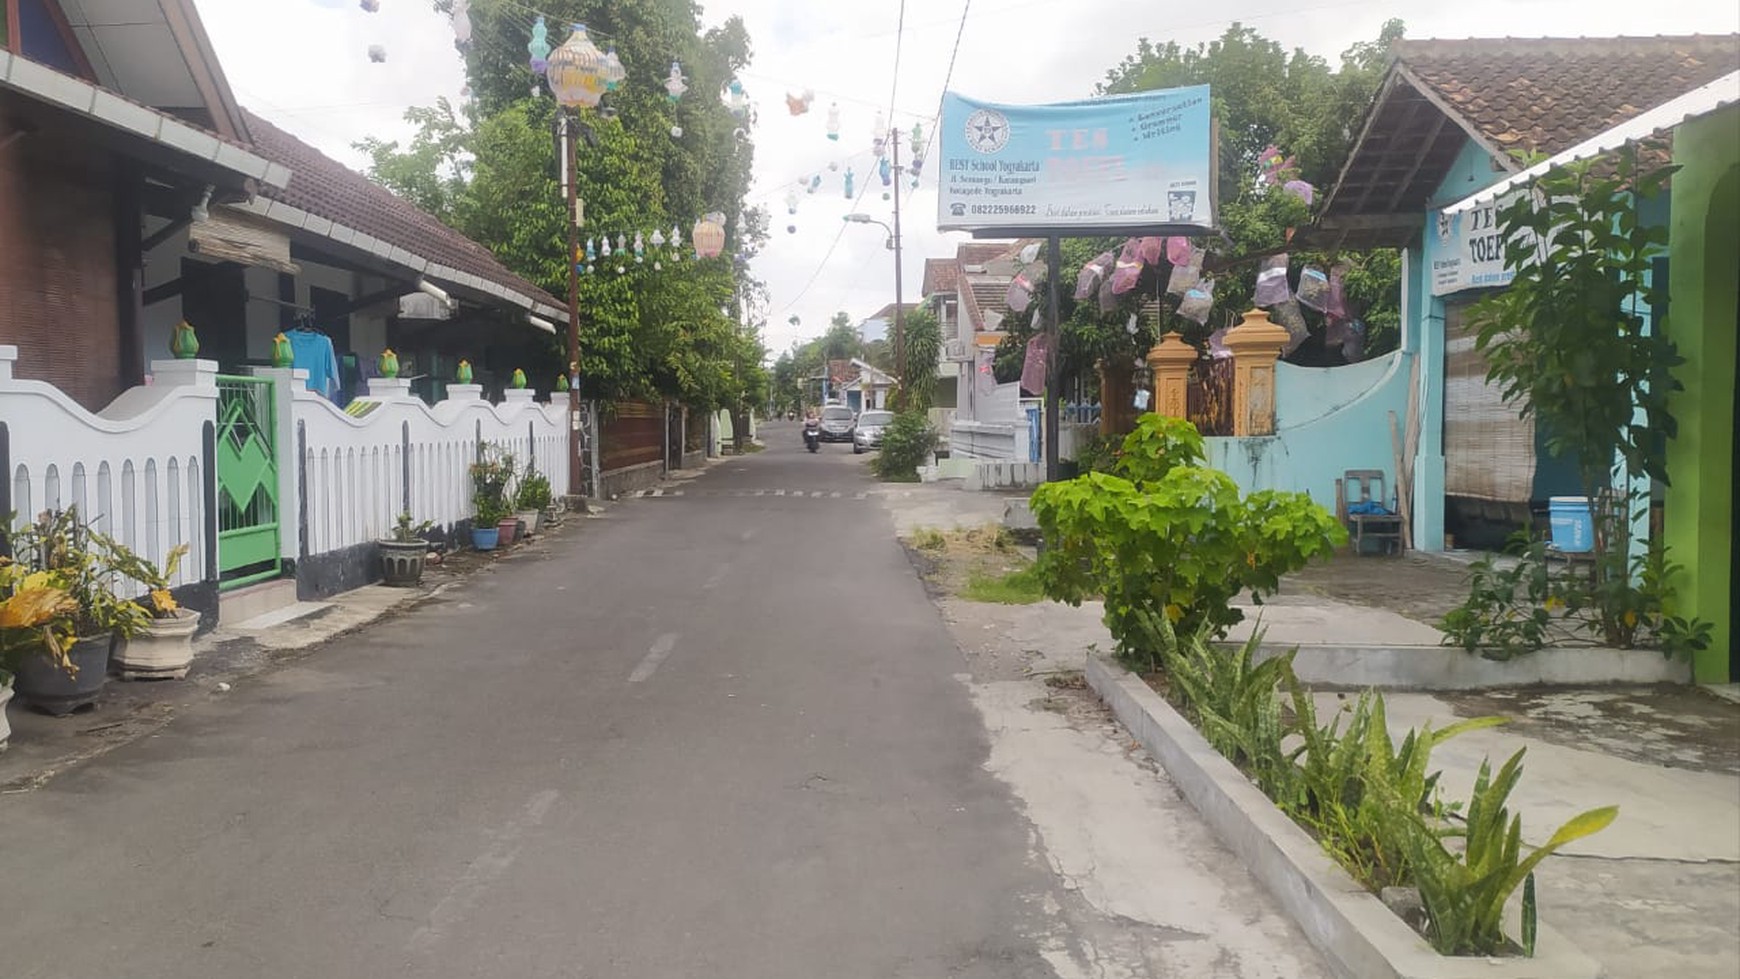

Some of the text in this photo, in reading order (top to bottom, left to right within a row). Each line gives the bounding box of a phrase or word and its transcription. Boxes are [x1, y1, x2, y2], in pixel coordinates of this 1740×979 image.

[971, 159, 998, 172] School
[999, 160, 1041, 174] Yogyakarta
[984, 187, 1023, 197] Yogyakarta
[1469, 234, 1504, 263] TOEF
